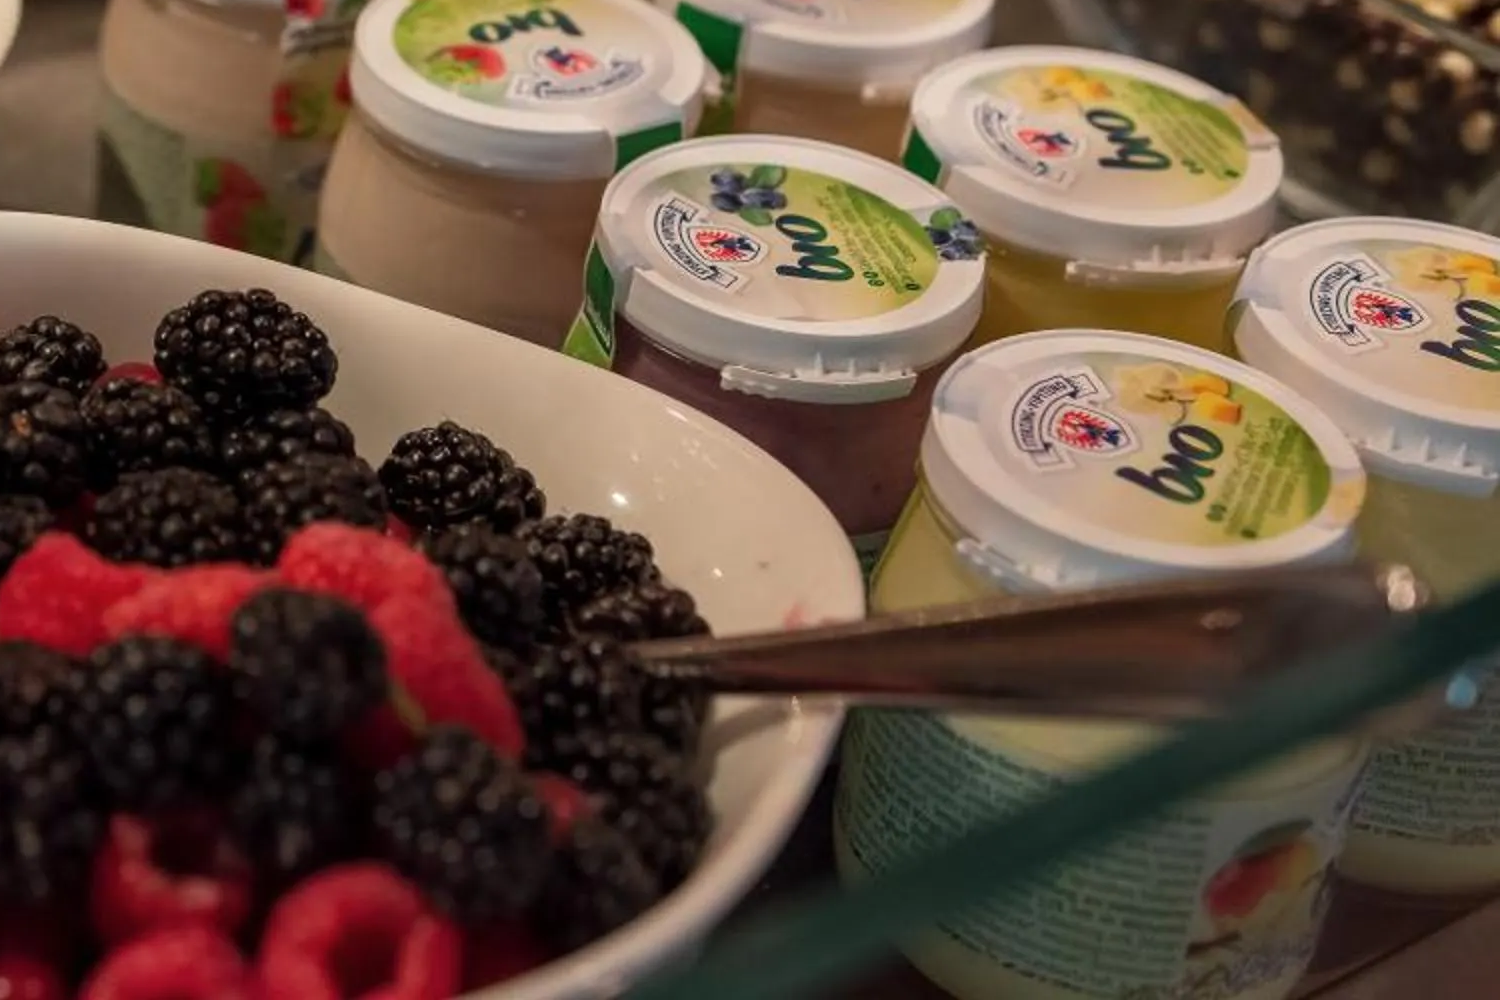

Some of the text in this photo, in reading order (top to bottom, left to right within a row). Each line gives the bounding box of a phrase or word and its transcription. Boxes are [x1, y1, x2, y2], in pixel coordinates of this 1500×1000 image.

[468, 7, 584, 44] bio
[1085, 109, 1172, 171] bio
[775, 213, 855, 282] bio
[1419, 299, 1500, 373] bio
[1115, 424, 1224, 505] bio
